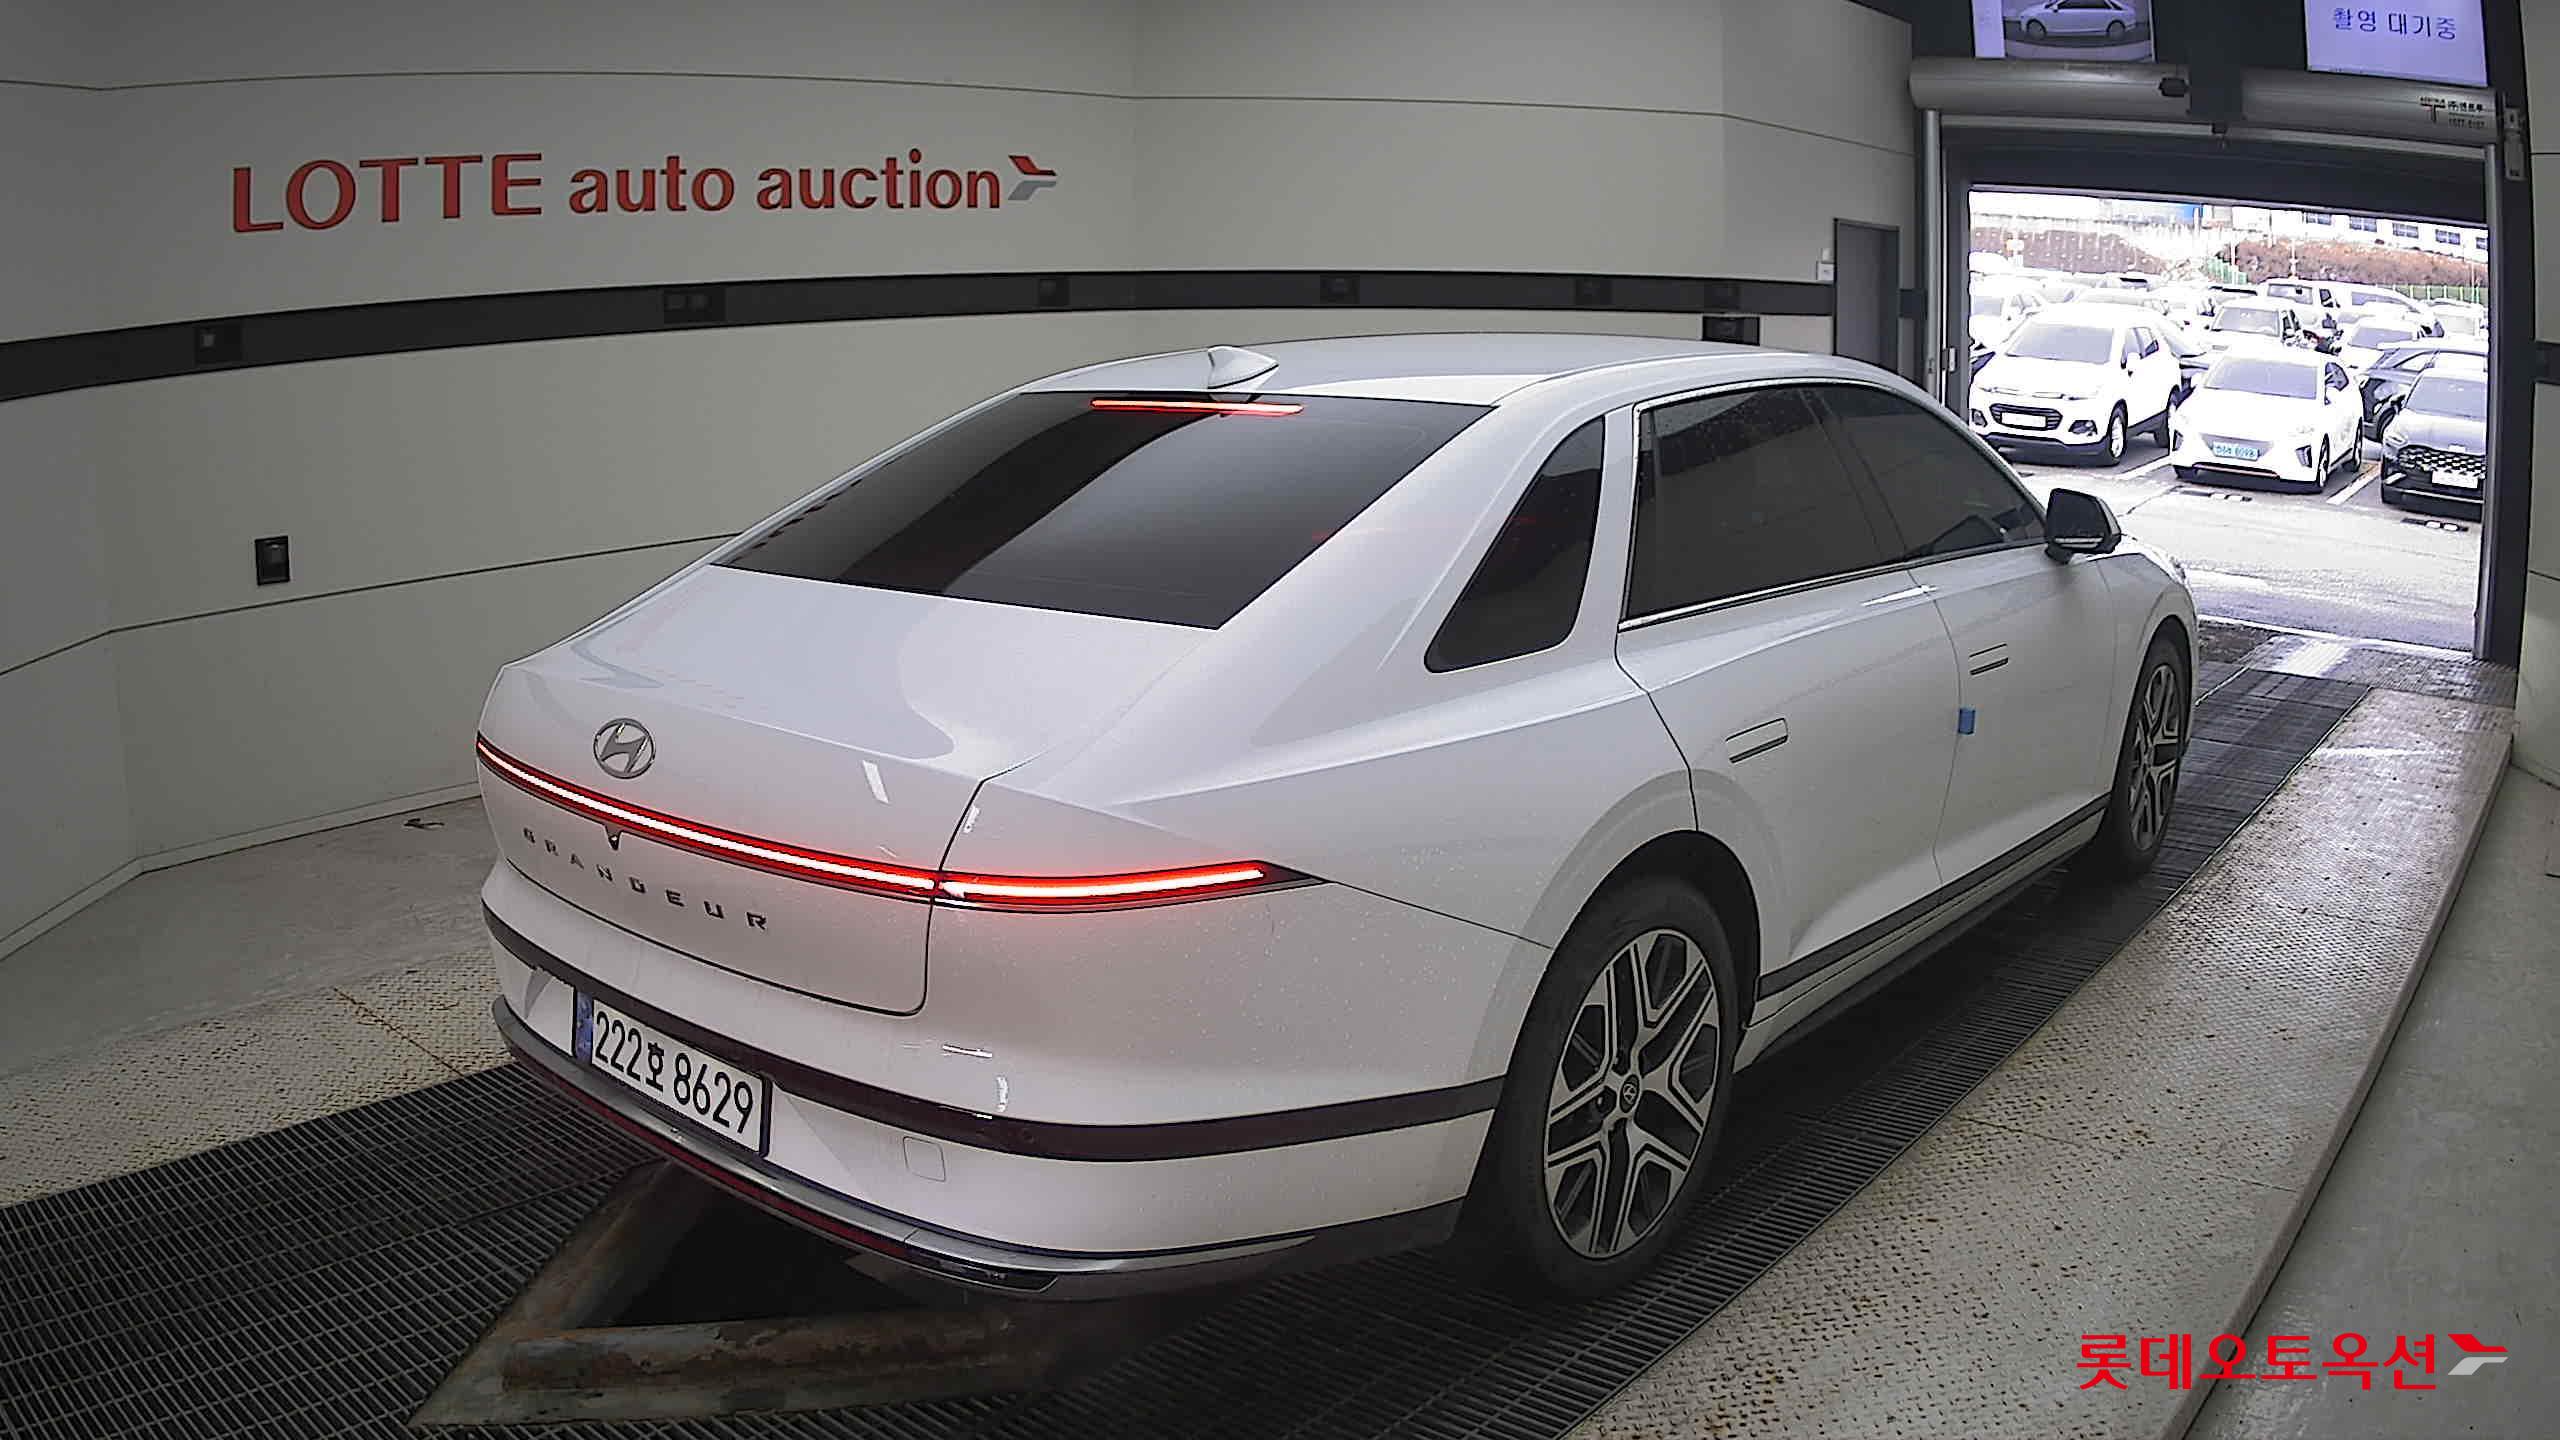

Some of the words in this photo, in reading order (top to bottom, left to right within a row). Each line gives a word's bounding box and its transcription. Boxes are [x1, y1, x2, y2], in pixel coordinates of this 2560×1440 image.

[2334, 7, 2377, 33] 촬영
[2388, 12, 2458, 41] 대기중
[233, 152, 543, 234] LOTTE
[569, 155, 735, 213] auto
[757, 148, 1002, 210] auction
[522, 827, 768, 931] GRANDEUR
